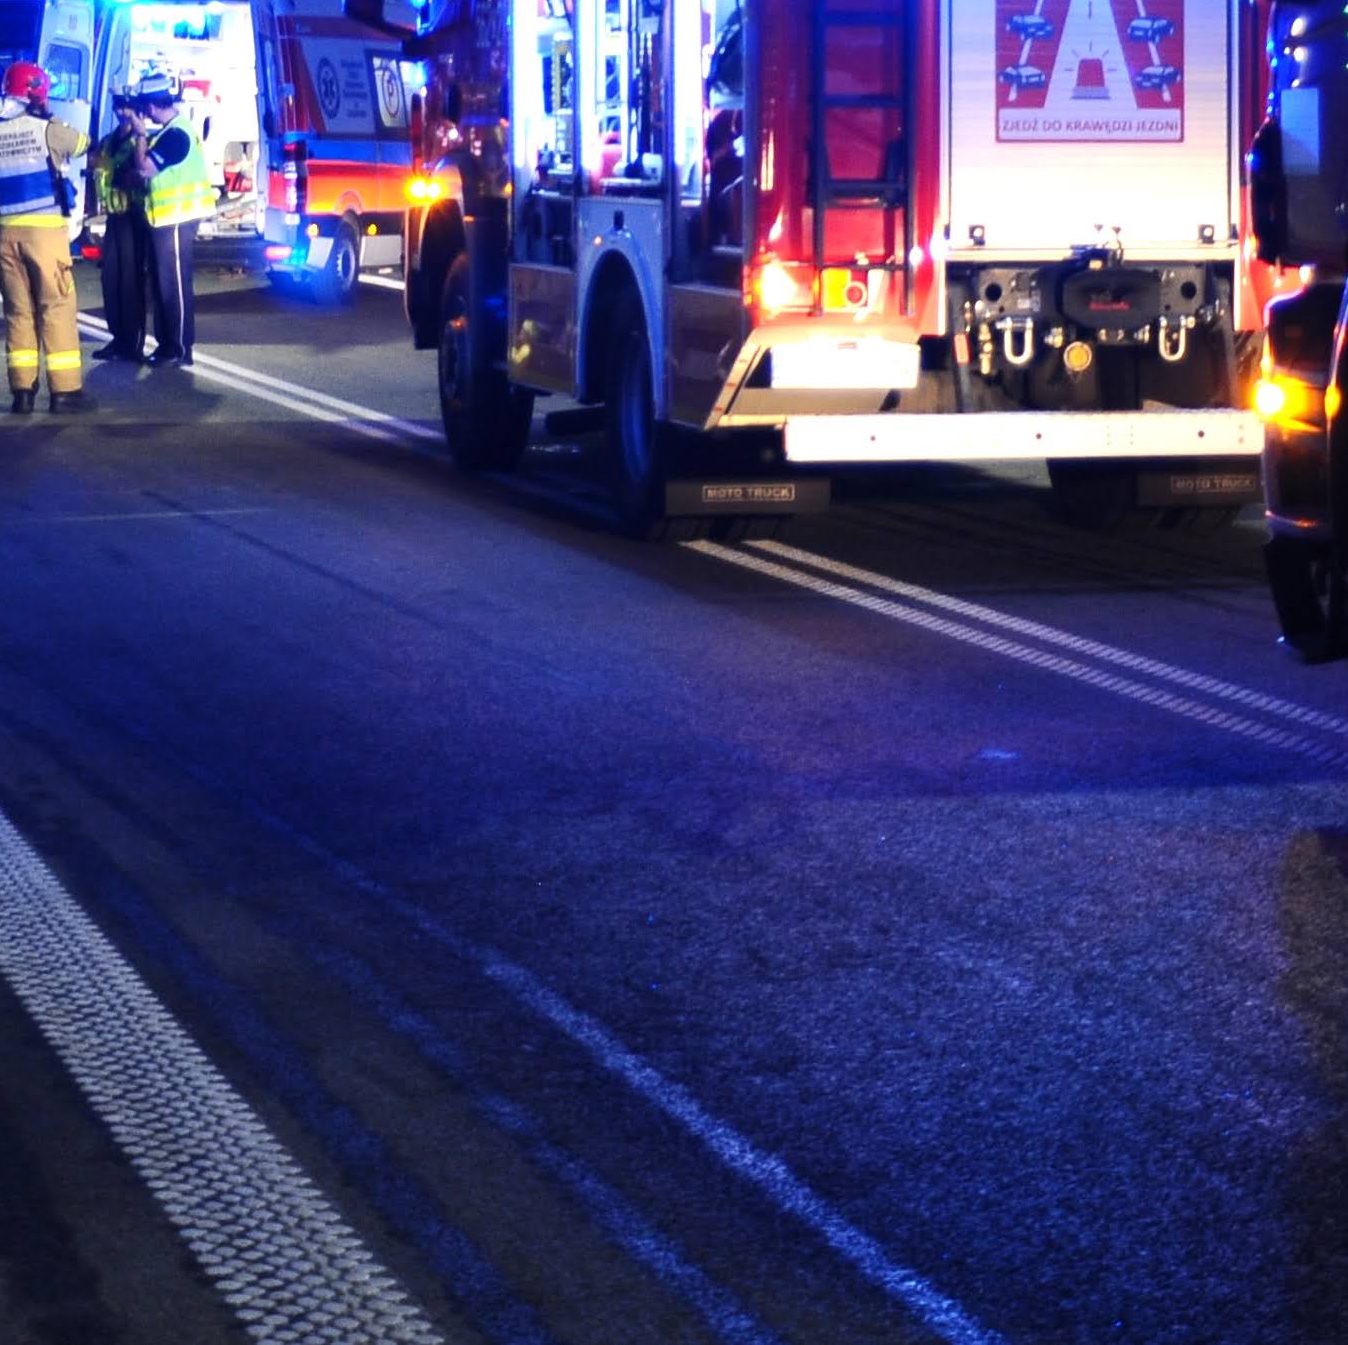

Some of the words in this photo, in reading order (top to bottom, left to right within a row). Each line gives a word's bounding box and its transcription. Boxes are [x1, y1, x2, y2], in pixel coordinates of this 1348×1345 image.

[1003, 118, 1039, 132] ZJEDŹ
[1043, 121, 1061, 132] DO
[1066, 121, 1133, 135] KRAWĘDZI
[1136, 121, 1179, 132] JEZDNI
[1214, 477, 1252, 488] TRUCK
[706, 487, 743, 497] MOTO
[748, 486, 790, 497] TRUCK
